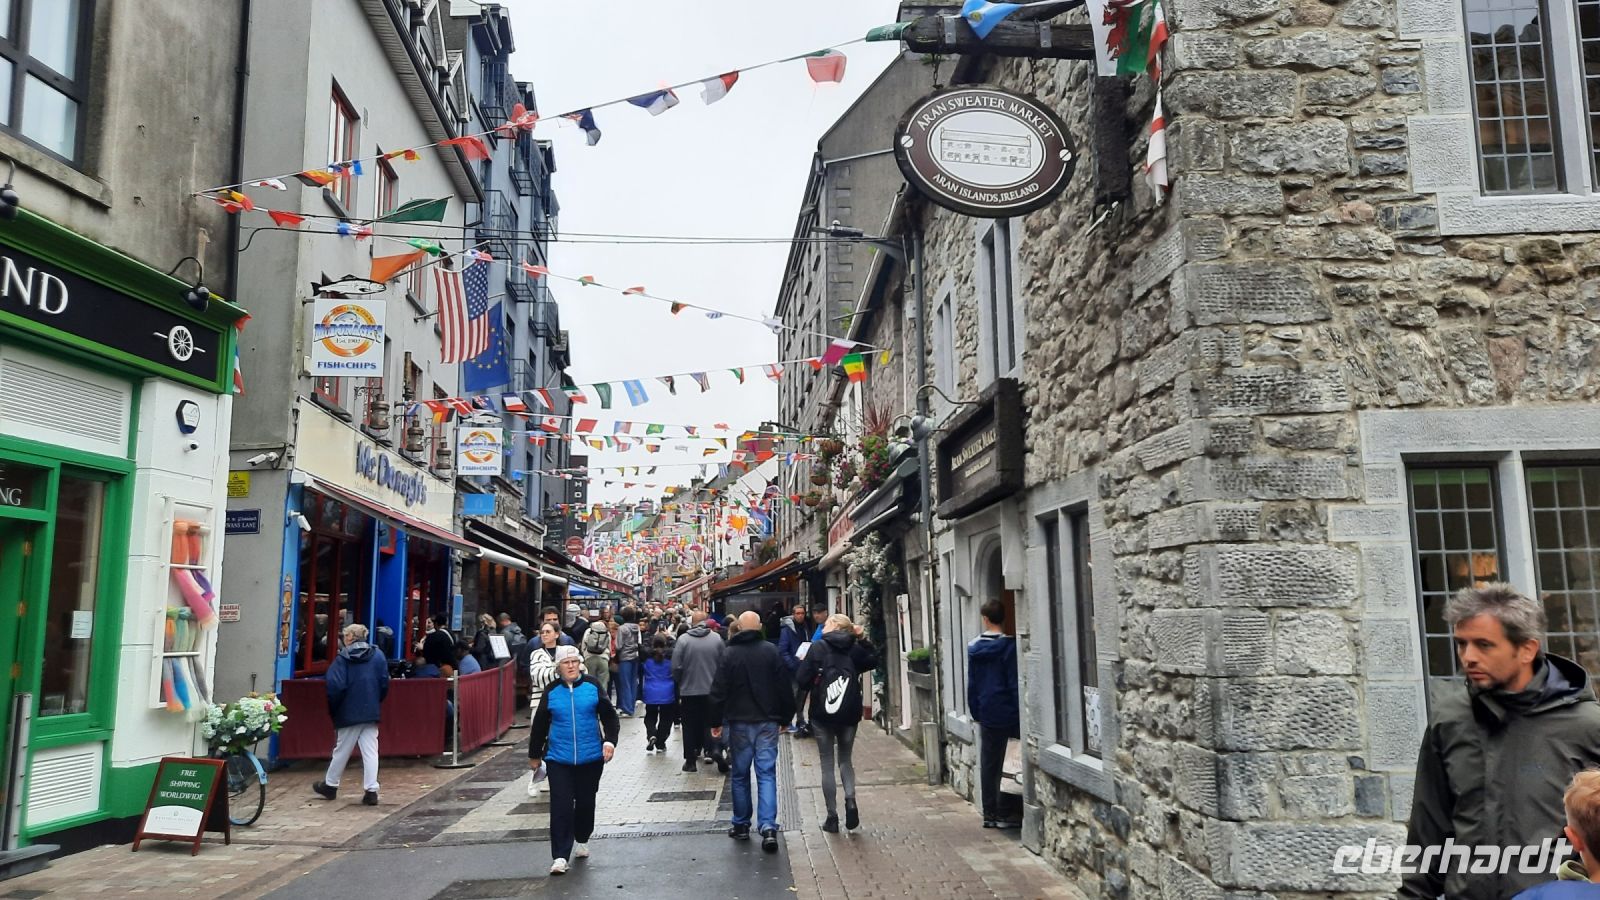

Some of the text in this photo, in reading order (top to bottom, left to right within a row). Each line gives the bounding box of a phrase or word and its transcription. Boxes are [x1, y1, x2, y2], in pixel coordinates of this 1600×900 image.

[916, 95, 1055, 138] ARAN SWEATER MARKET
[932, 173, 959, 193] ARAN
[1, 255, 69, 315] ND
[180, 769, 197, 777] FREE
[169, 780, 201, 789] SHIPPING
[160, 791, 204, 800] WORLDWIDE
